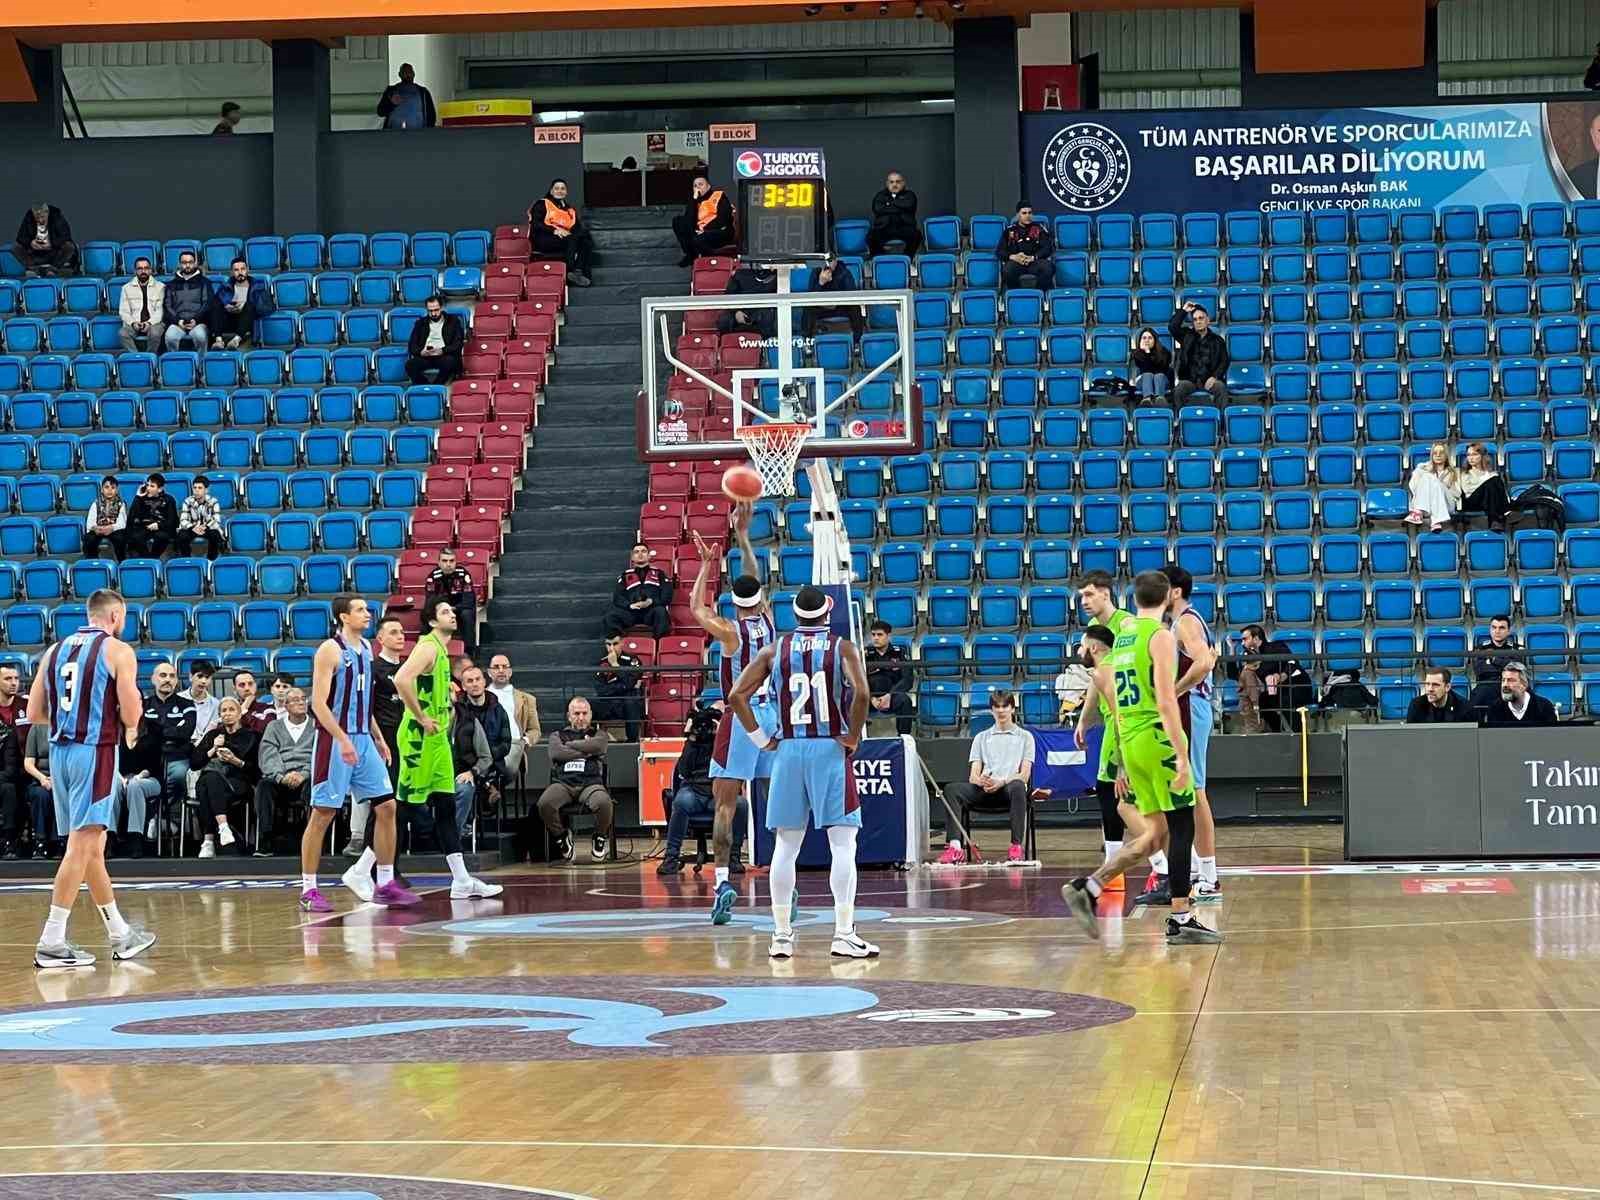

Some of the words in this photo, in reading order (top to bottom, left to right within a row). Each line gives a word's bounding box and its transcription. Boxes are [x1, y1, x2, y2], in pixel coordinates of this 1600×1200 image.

[548, 132, 576, 141] BLOK
[723, 129, 751, 139] BLOK
[1139, 126, 1187, 147] TÜM
[1192, 124, 1307, 146] ANTRENÖR
[1310, 125, 1337, 144] VE
[1343, 120, 1533, 143] SPORCULARIMIZA
[1195, 153, 1335, 180] BAŞARILAR
[1342, 148, 1486, 173] DİLİYORUM
[763, 183, 812, 208] 3:30
[1271, 183, 1290, 195] Dr.
[1292, 182, 1338, 194] Osman
[1341, 181, 1377, 195] Aşkın
[1380, 180, 1408, 192] BAK
[60, 662, 79, 712] 3
[789, 671, 830, 725] 21
[1115, 669, 1140, 707] 25
[1525, 798, 1598, 825] Tam
